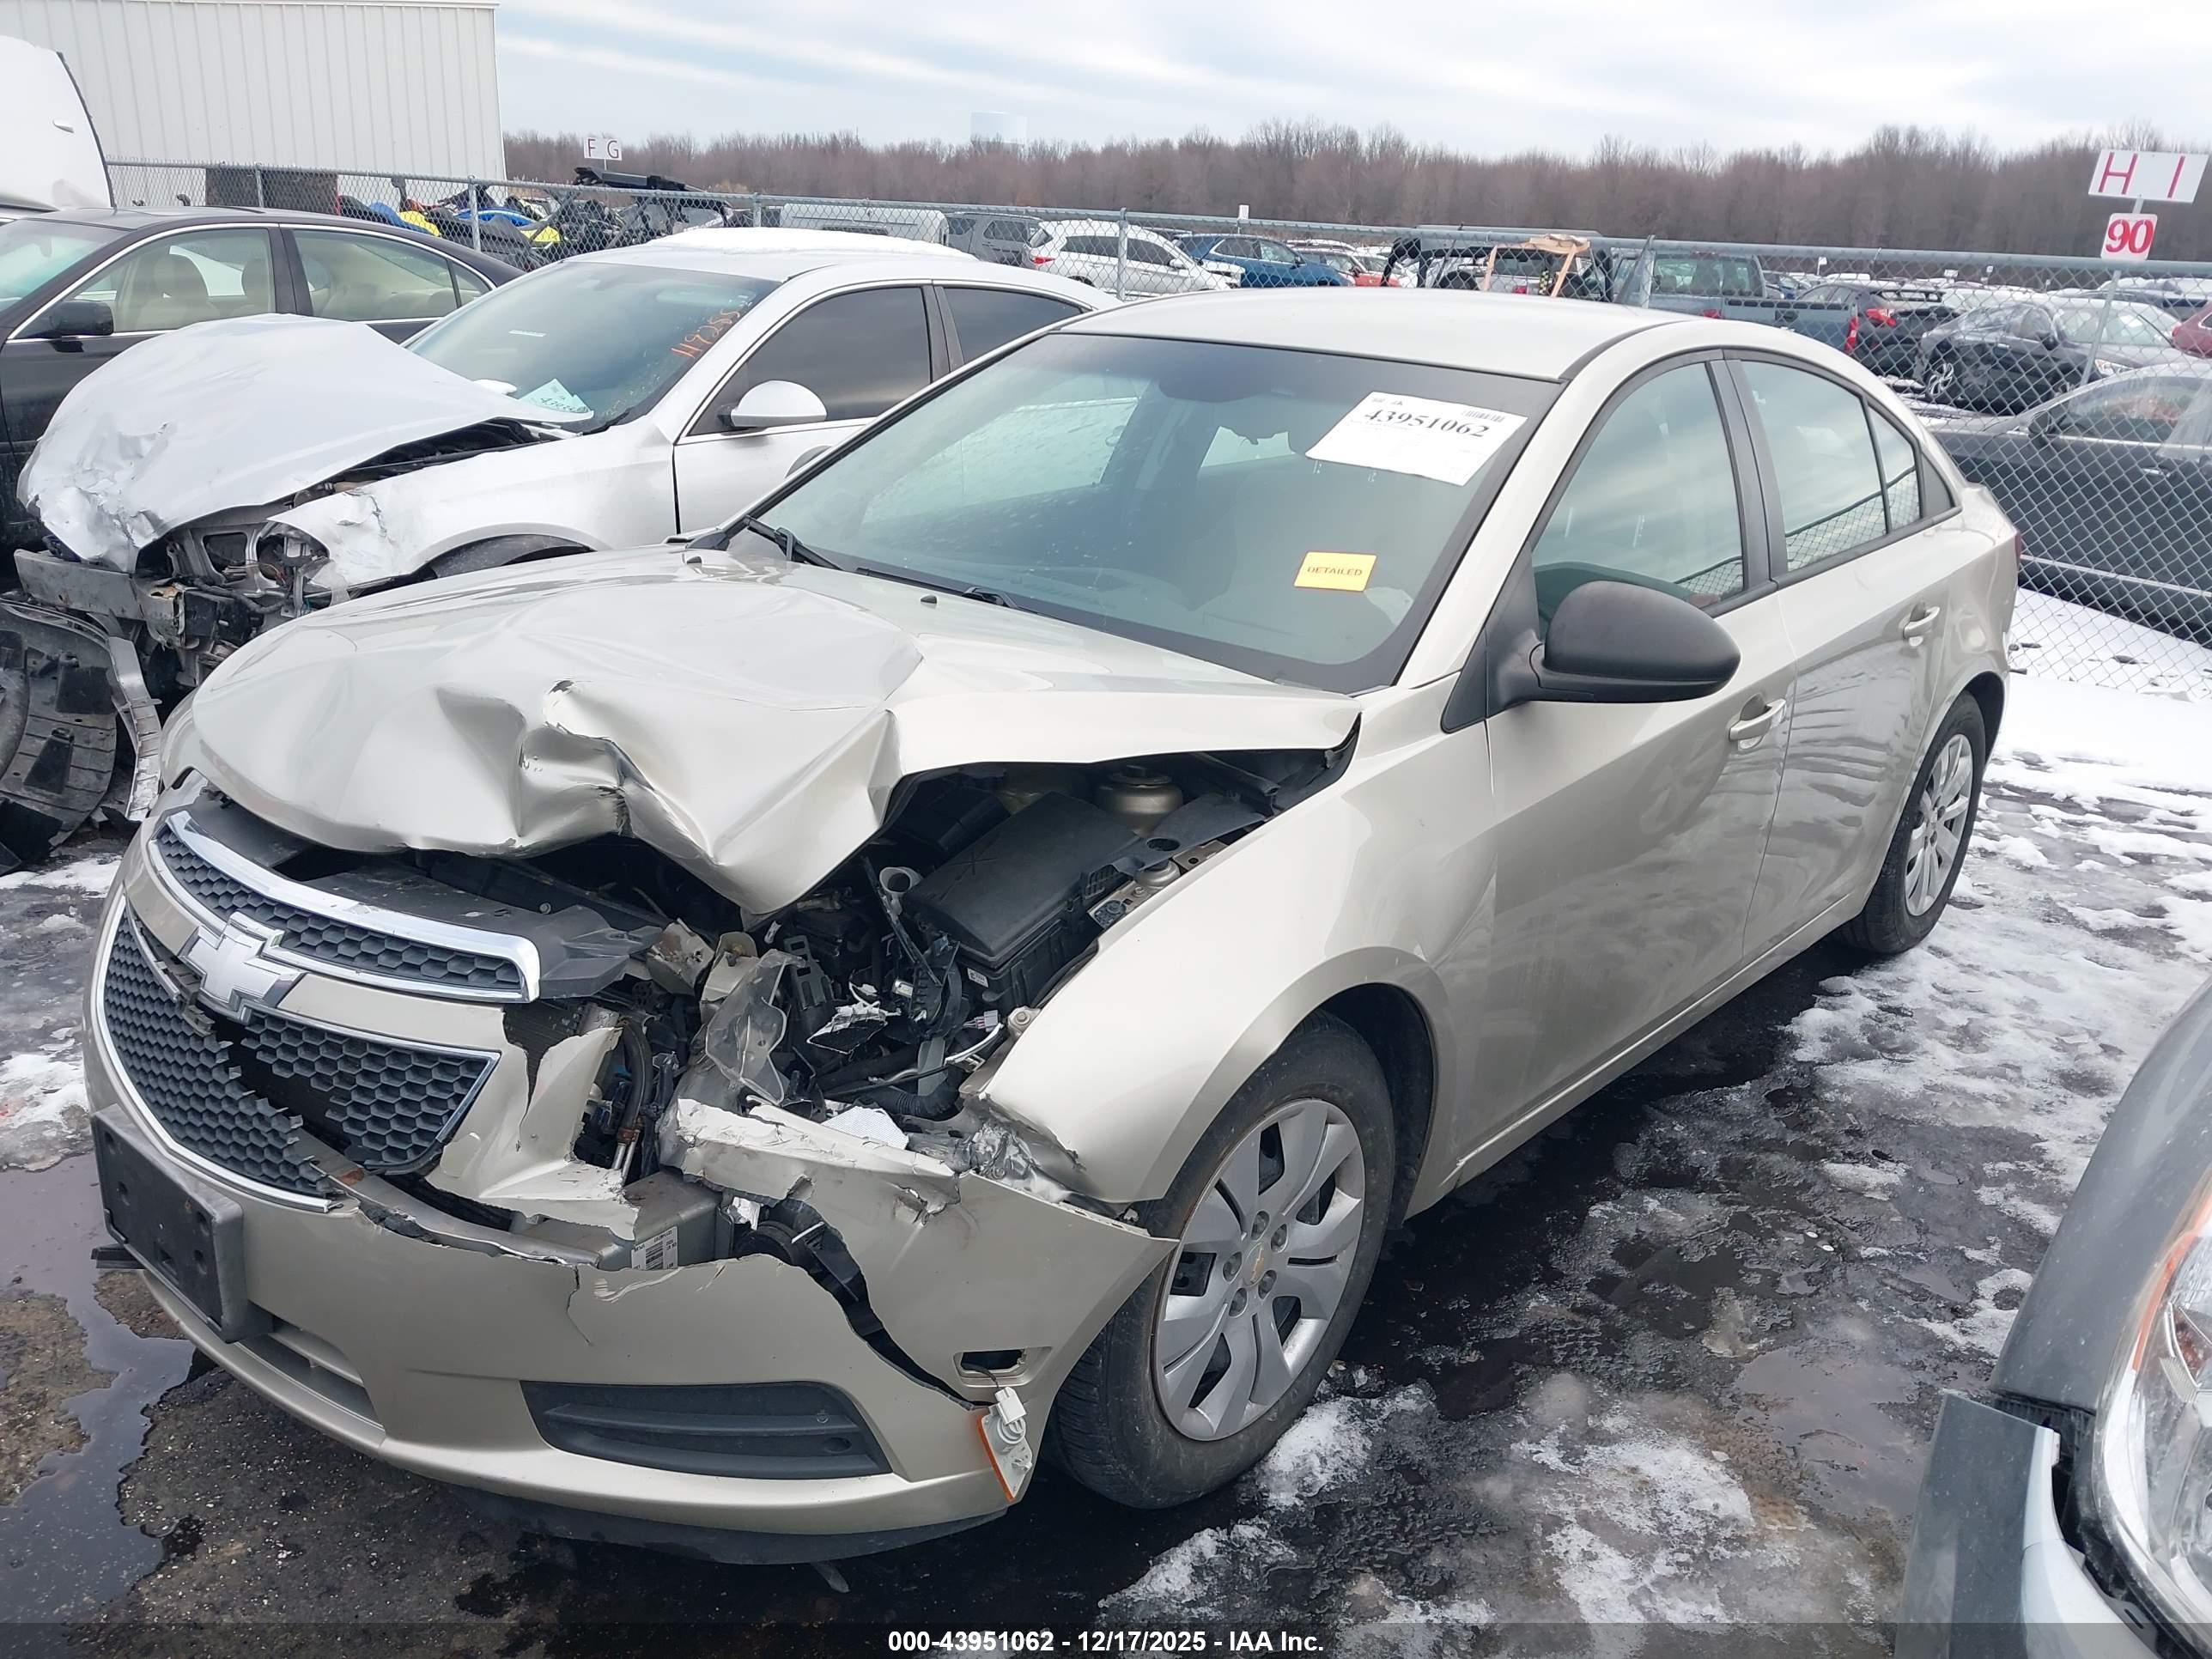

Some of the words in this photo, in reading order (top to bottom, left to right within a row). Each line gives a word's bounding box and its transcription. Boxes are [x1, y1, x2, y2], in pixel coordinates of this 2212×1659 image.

[587, 138, 596, 157] F
[606, 140, 619, 159] G
[2098, 152, 2138, 195] H
[2106, 219, 2154, 253] 90
[1364, 409, 1491, 438] 43951062
[1306, 566, 1364, 576] DETAILED
